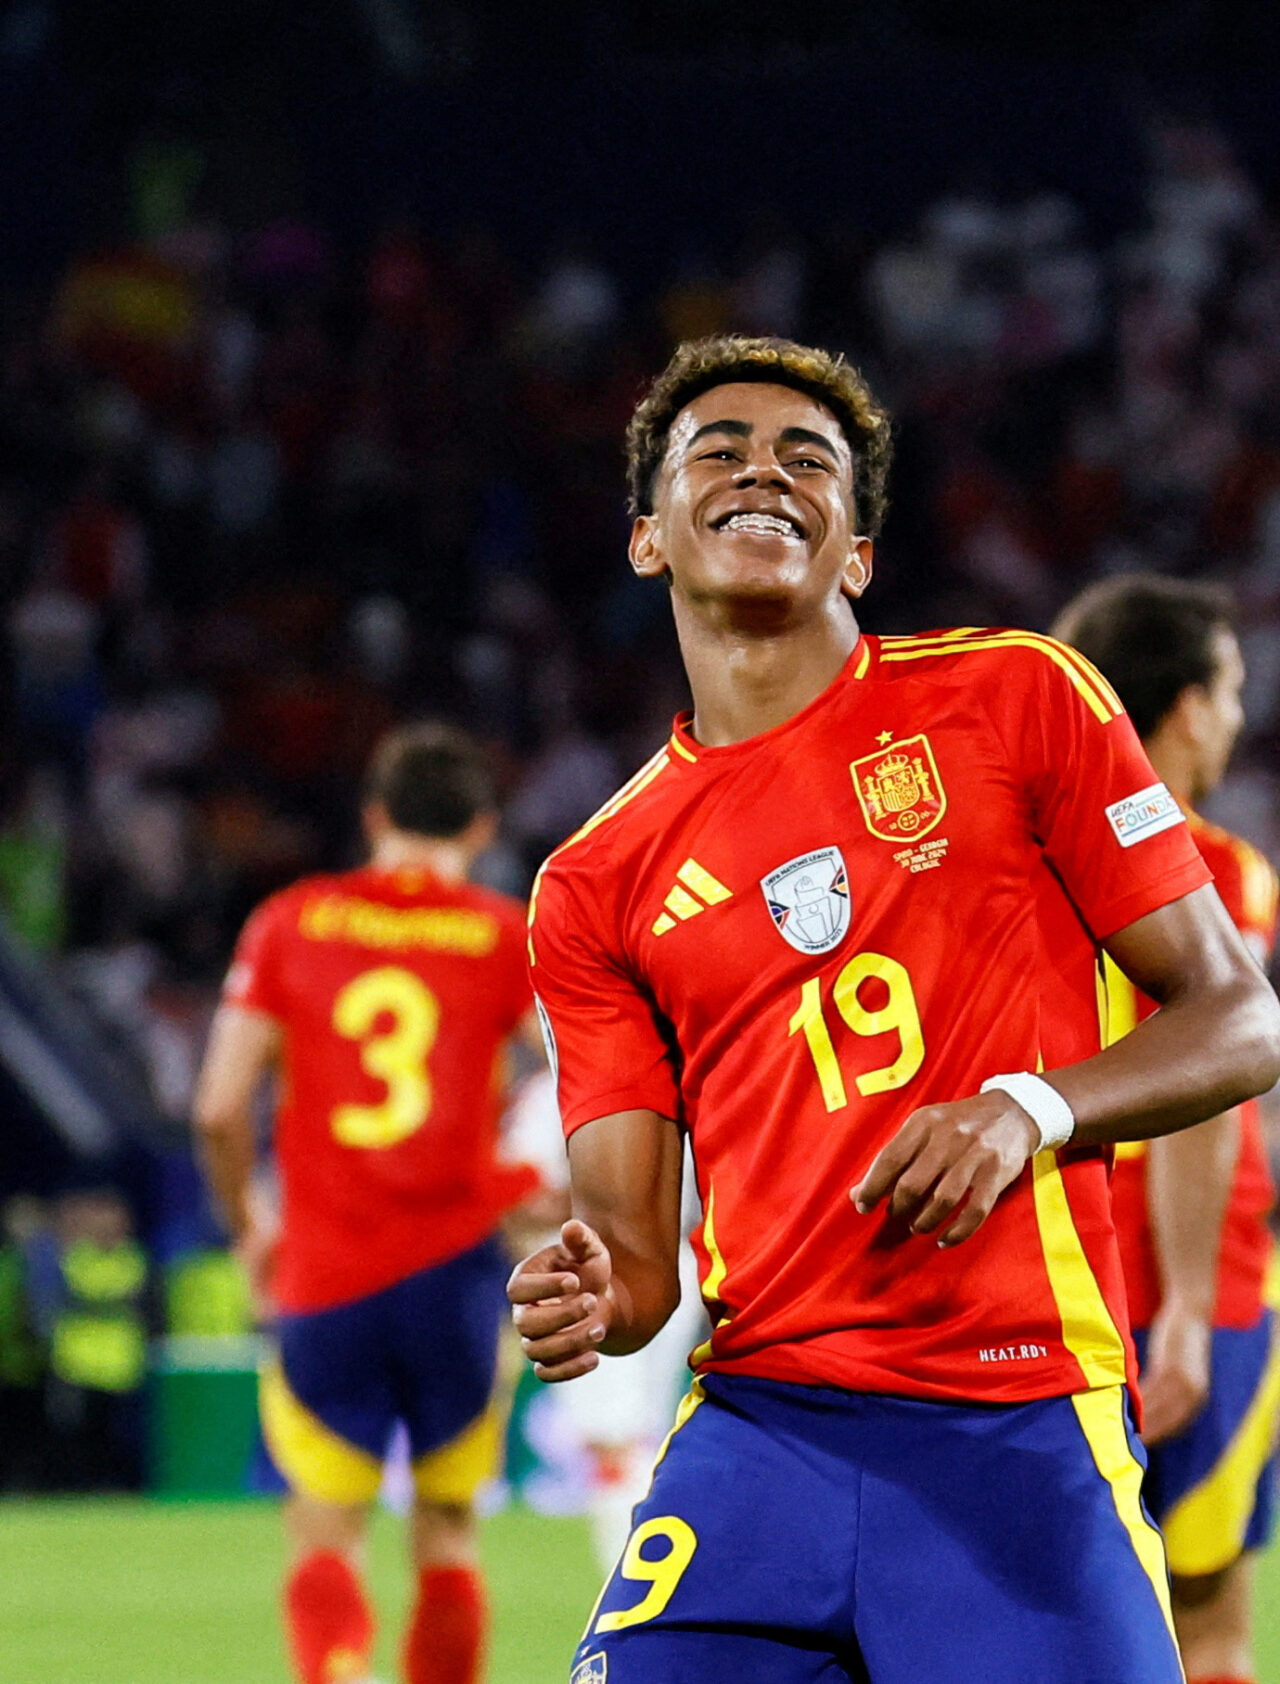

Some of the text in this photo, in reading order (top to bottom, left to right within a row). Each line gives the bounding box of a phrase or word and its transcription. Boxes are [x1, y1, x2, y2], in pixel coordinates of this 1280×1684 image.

[1111, 801, 1133, 817] UEFA
[1115, 796, 1175, 832] FOUNDA
[809, 850, 834, 861] LEAGUE
[788, 952, 925, 1113] 19
[331, 965, 441, 1148] 3
[979, 1344, 1047, 1362] HEAT.RDY
[583, 1515, 698, 1642] 9
